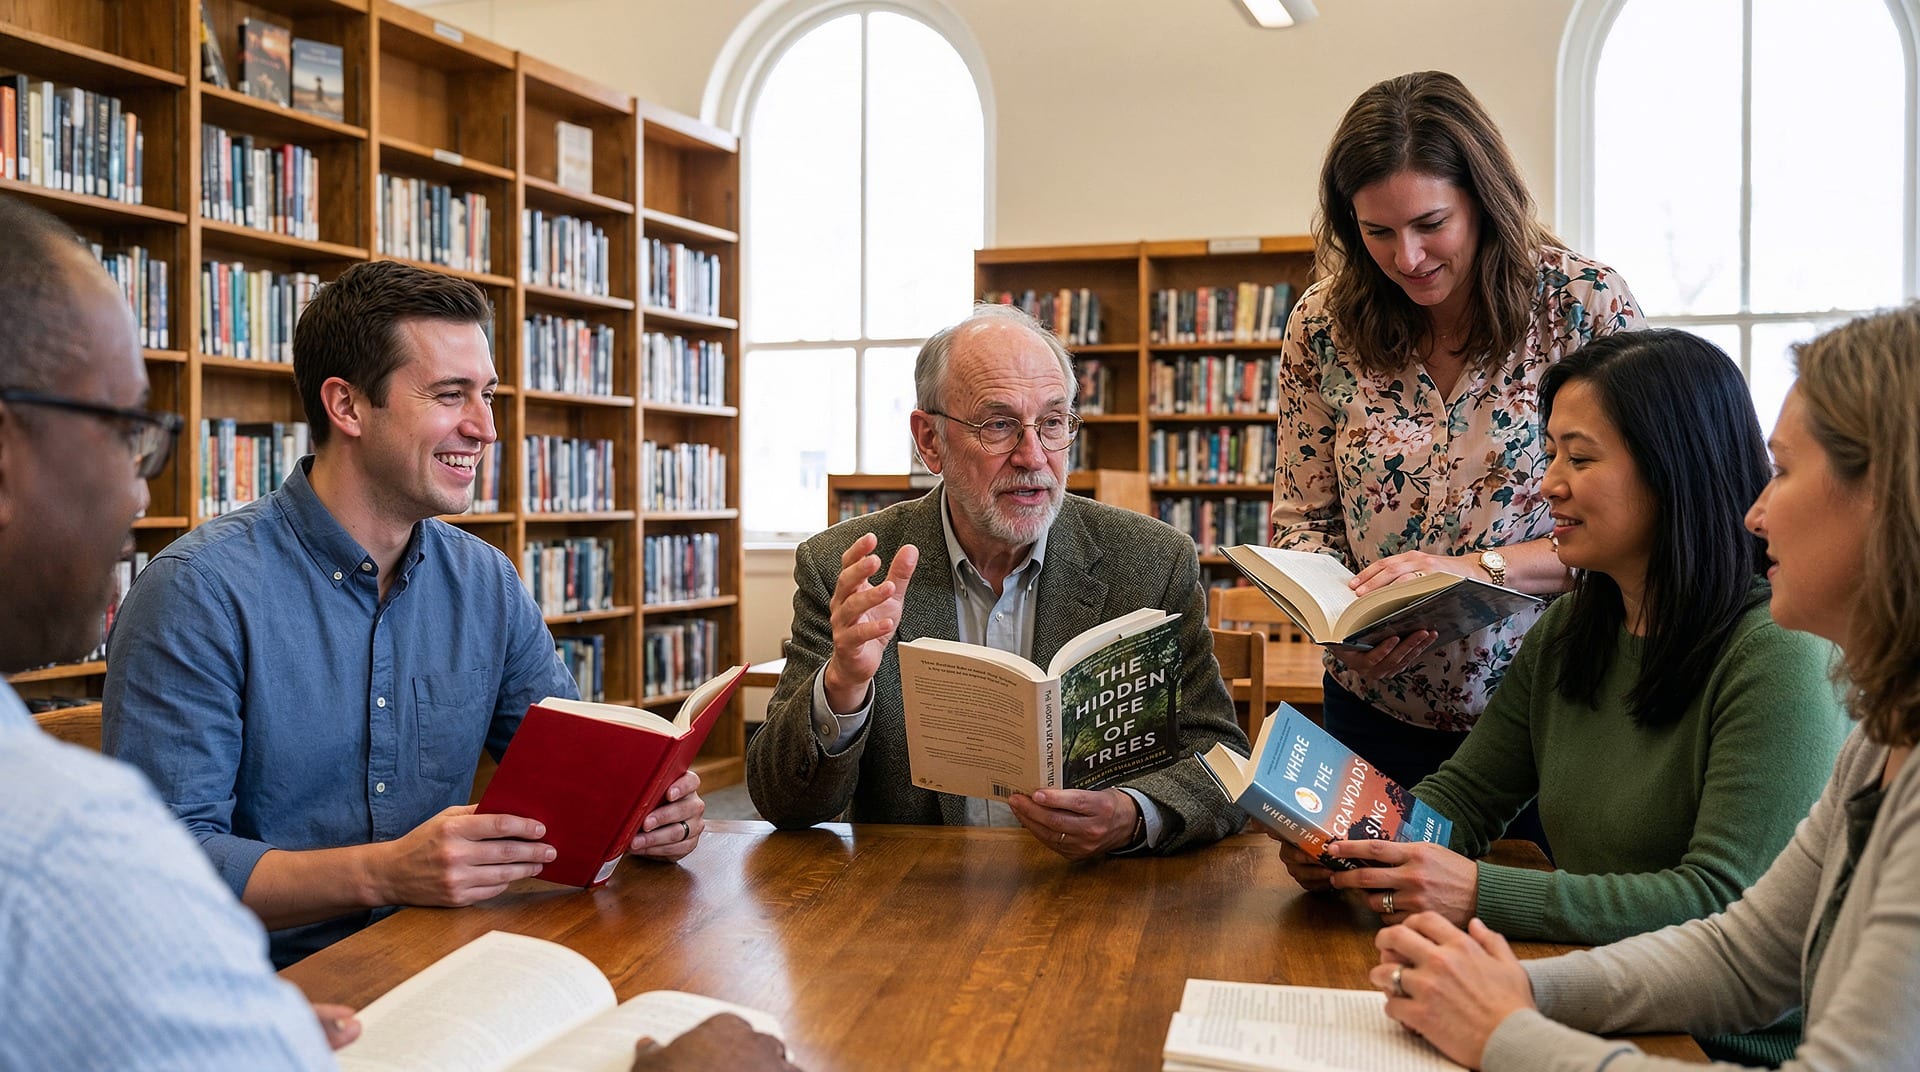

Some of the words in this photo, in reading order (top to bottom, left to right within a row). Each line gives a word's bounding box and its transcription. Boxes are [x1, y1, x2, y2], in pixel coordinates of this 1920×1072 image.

[1096, 656, 1144, 687] THE
[1076, 668, 1165, 720] HIDDEN
[1095, 696, 1144, 728] LIFE
[1103, 718, 1136, 742] OF
[1084, 731, 1155, 769] TREES
[1283, 734, 1310, 784] WHERE
[1313, 761, 1334, 793] THE
[1332, 758, 1369, 839] CRAWDADS
[1261, 801, 1297, 832] WHERE
[1299, 827, 1321, 846] THE
[1365, 800, 1388, 840] SING
